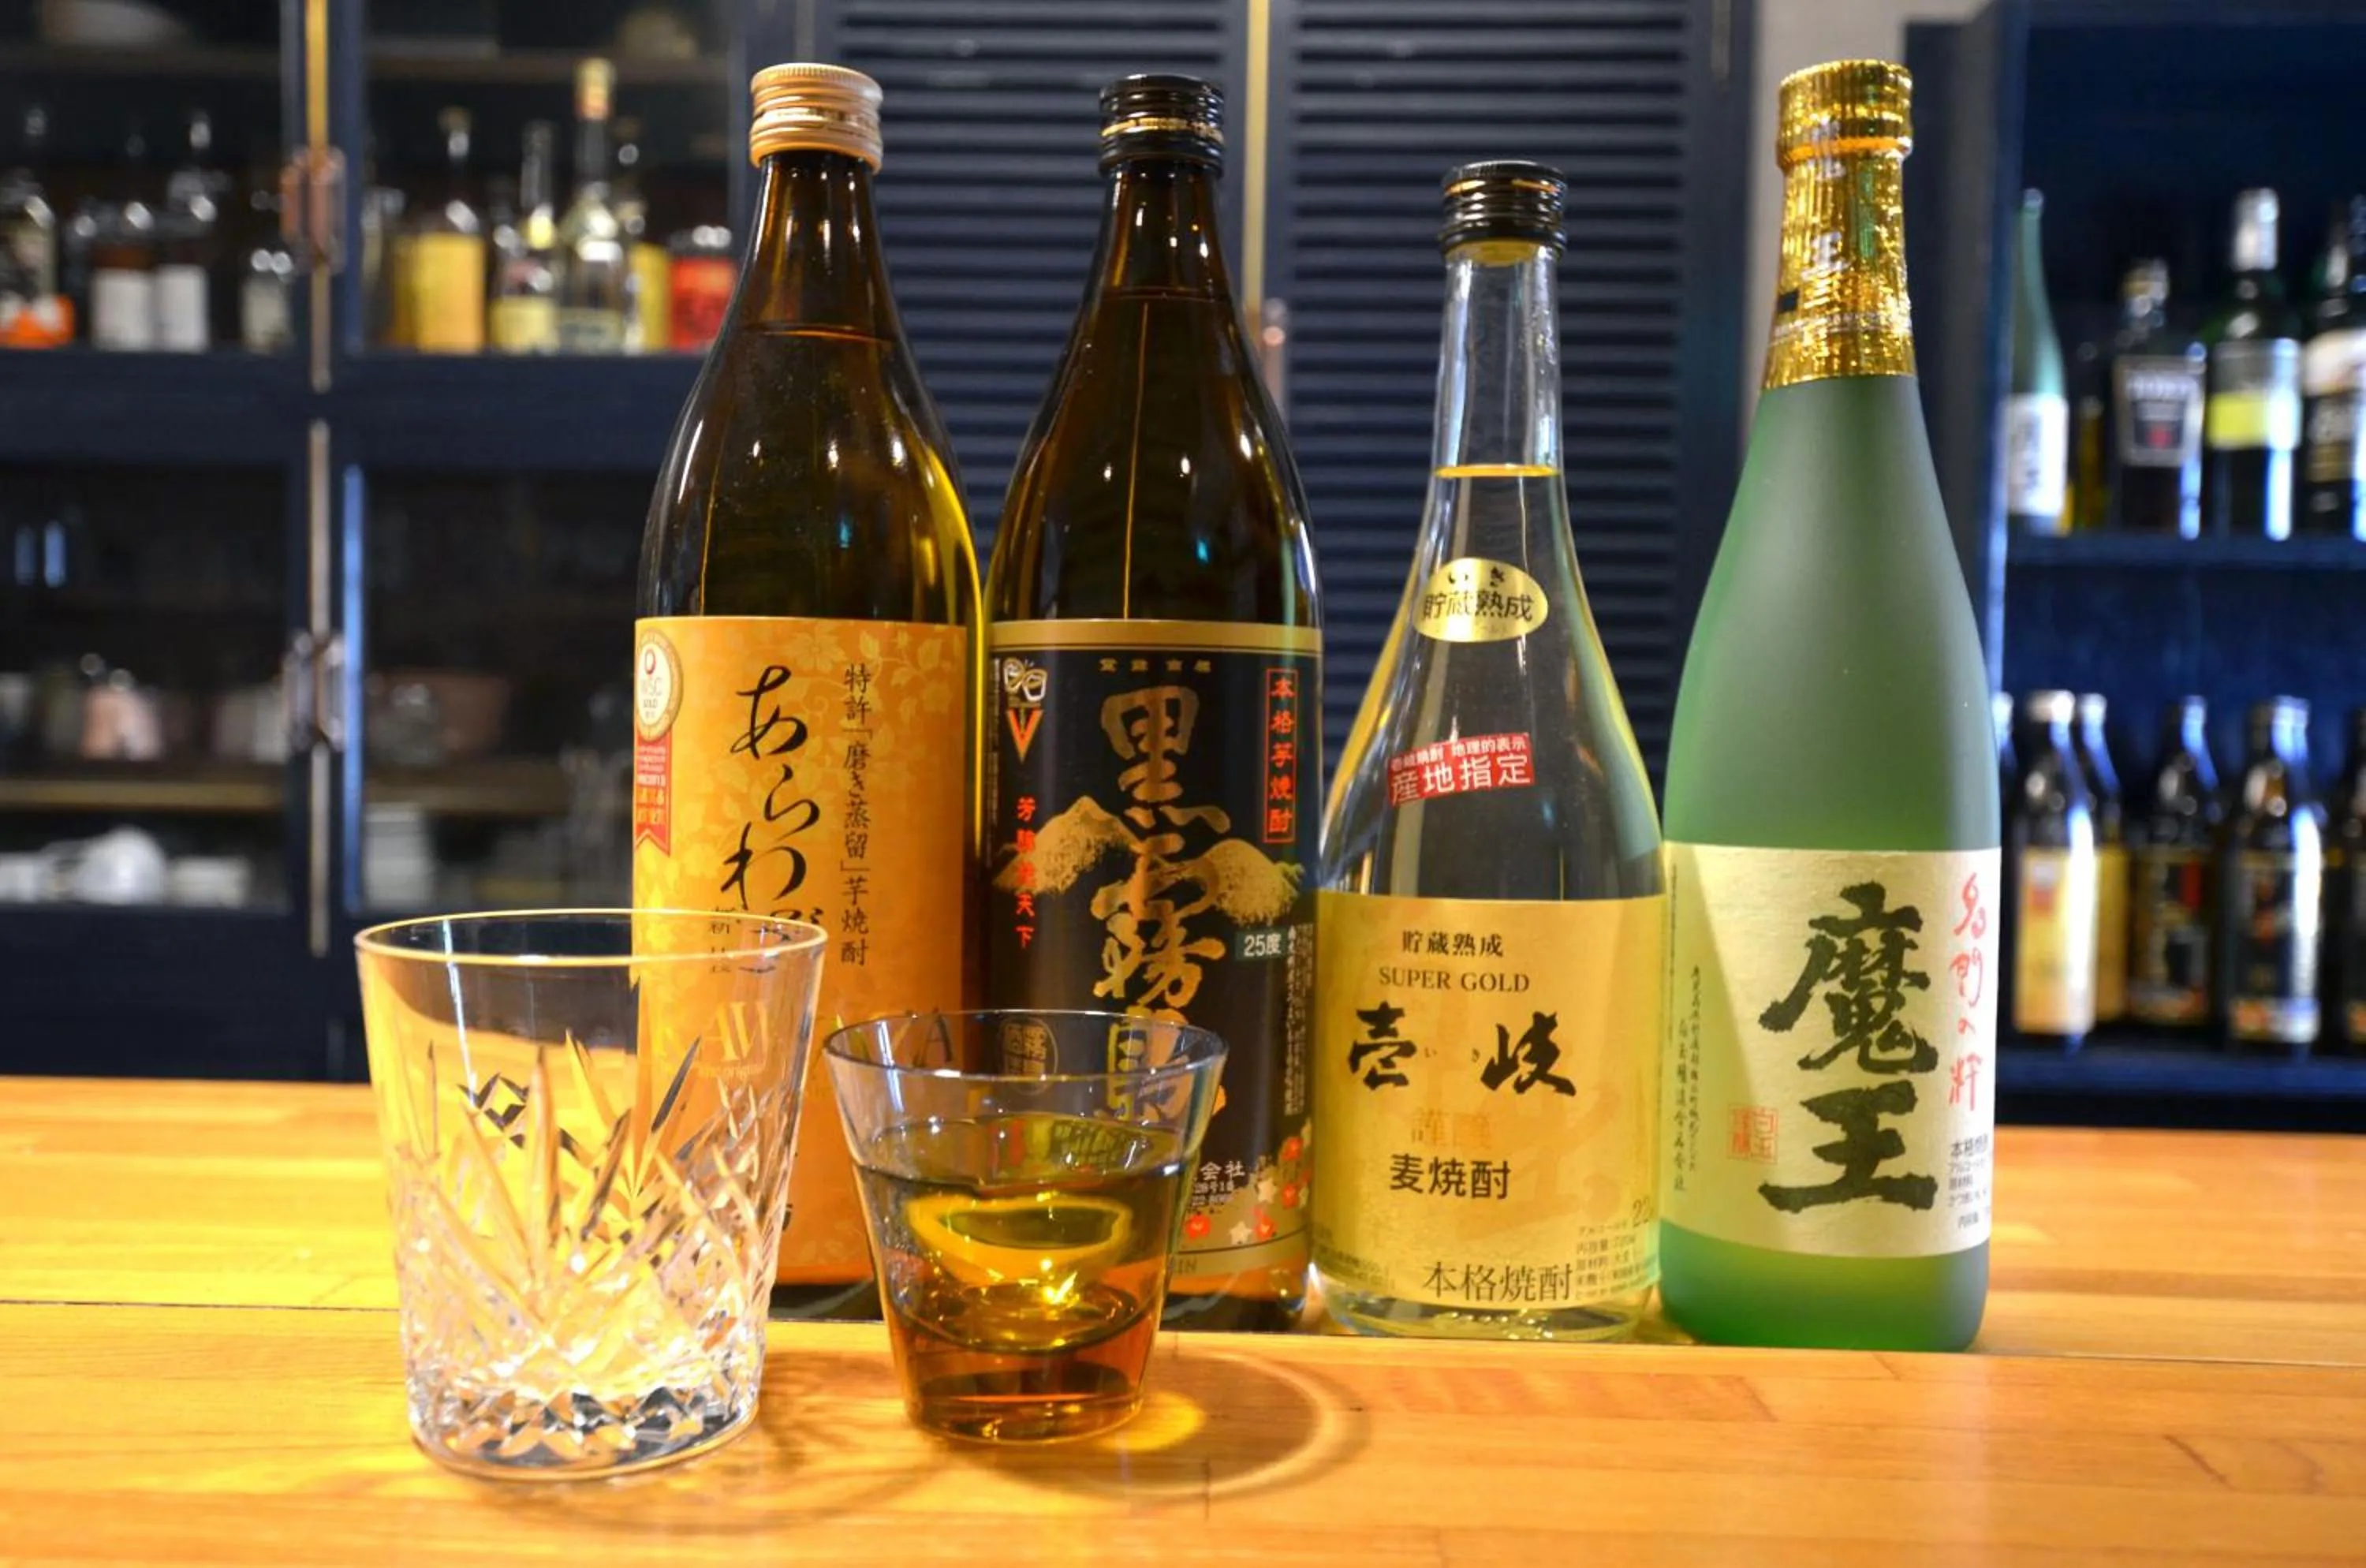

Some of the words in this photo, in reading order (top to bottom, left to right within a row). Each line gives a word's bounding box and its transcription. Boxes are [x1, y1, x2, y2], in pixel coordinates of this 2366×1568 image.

[1390, 754, 1531, 806] 産地指定
[1243, 931, 1282, 958] 25度
[1401, 930, 1505, 958] 貯蔵熟成
[1379, 966, 1452, 990] SUPER
[1461, 972, 1531, 993] GOLD
[1758, 880, 1939, 1214] 魔王
[1200, 1160, 1246, 1182] 会社
[1390, 1154, 1511, 1200] 麦焼酎
[1422, 1261, 1573, 1302] 本格焼酎
